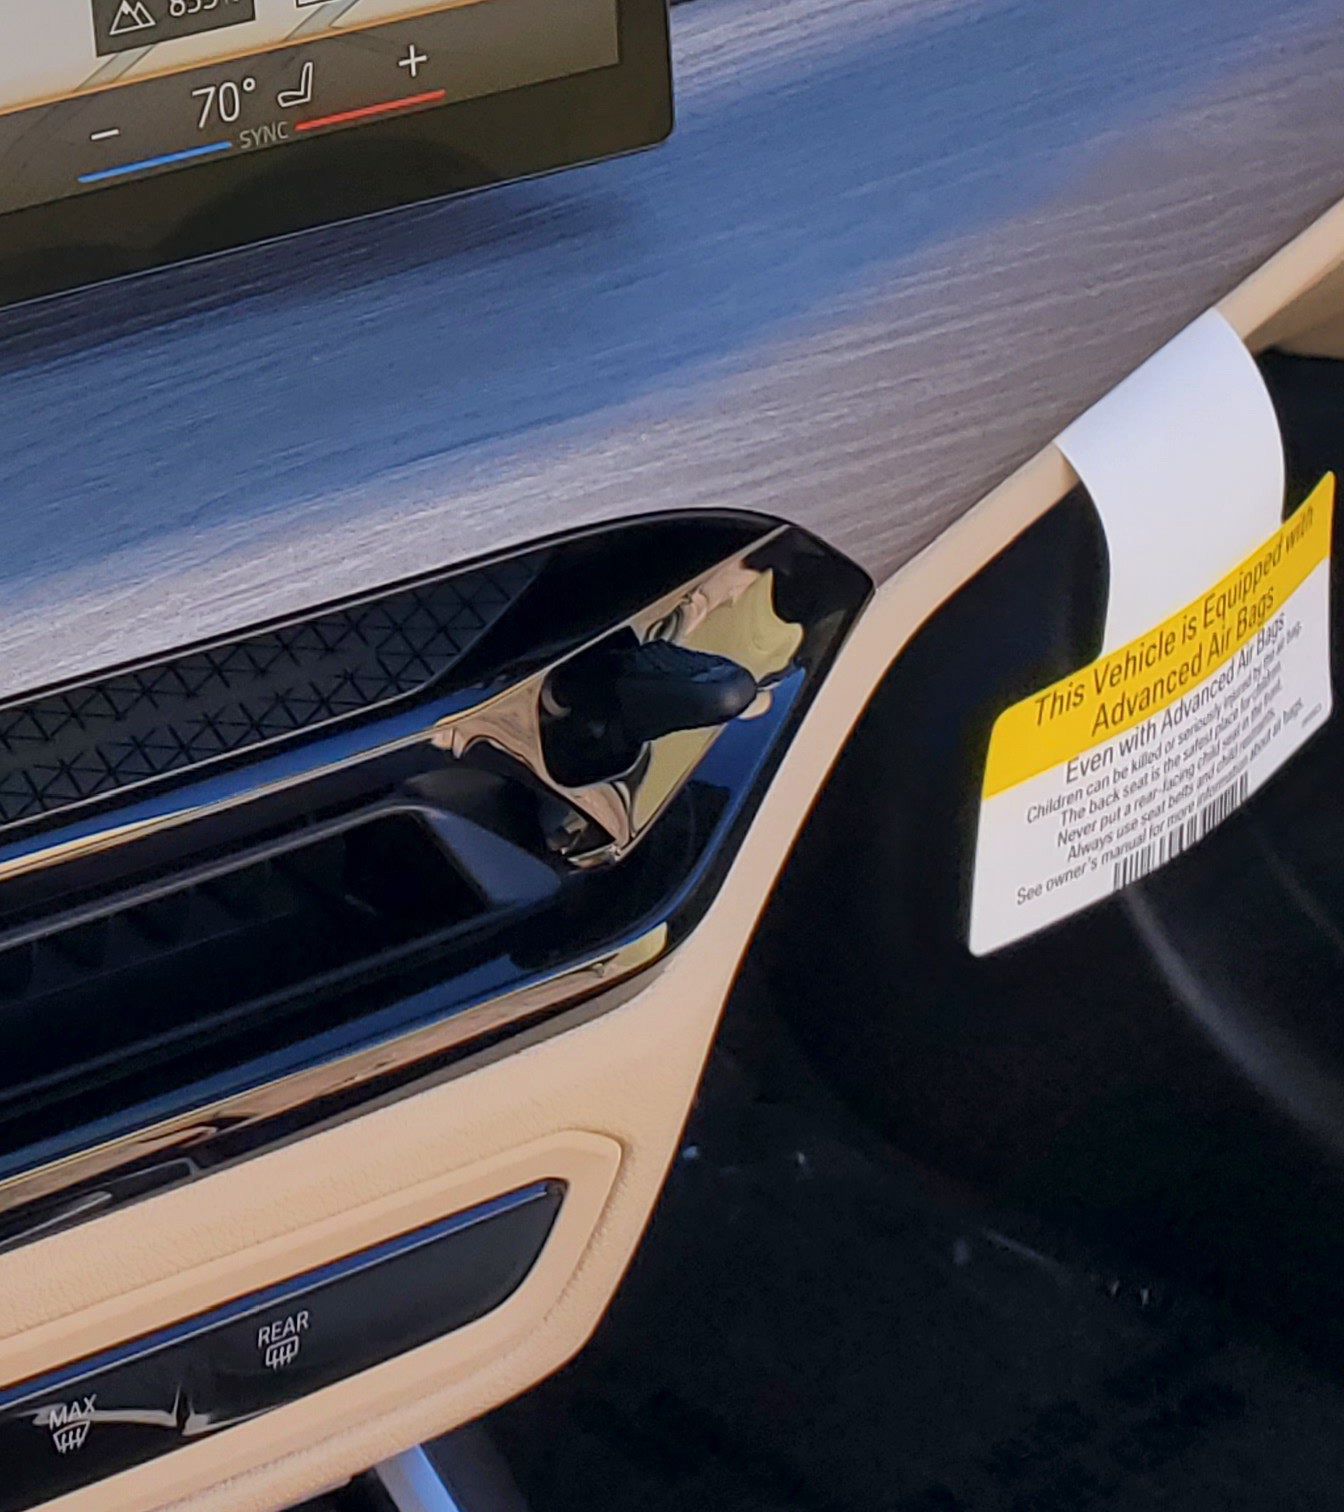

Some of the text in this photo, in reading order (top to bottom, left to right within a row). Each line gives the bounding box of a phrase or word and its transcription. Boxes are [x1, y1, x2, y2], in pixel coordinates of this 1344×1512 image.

[192, 78, 257, 129] 70°
[238, 120, 290, 150] SYNC
[1034, 506, 1315, 727] This Vehicle is Equipped with
[1065, 612, 1285, 785] Even with Advanced Air Bags
[1091, 586, 1275, 738] Advanced Air Bags
[1026, 784, 1083, 825] Children
[1086, 774, 1110, 795] can
[1112, 766, 1128, 785] be
[1131, 747, 1162, 777] killed
[1164, 734, 1177, 753] or
[1060, 807, 1086, 828] The
[1089, 787, 1120, 815] back
[1123, 774, 1149, 797] seat
[1150, 764, 1161, 783] is
[1163, 753, 1181, 776] the
[1183, 727, 1213, 763] safest
[1016, 883, 1043, 907] See
[1045, 856, 1098, 893] owner's
[1100, 829, 1147, 867] manual
[1148, 817, 1166, 840] for
[1166, 800, 1196, 829] more
[1057, 821, 1097, 849] Never
[1099, 807, 1121, 834] put
[1123, 801, 1132, 817] a
[1066, 831, 1113, 864] Always
[1115, 818, 1138, 840] use
[1140, 799, 1166, 824] seat
[1167, 782, 1195, 811] belts
[257, 1310, 311, 1350] REAR
[48, 1392, 99, 1430] MAX
